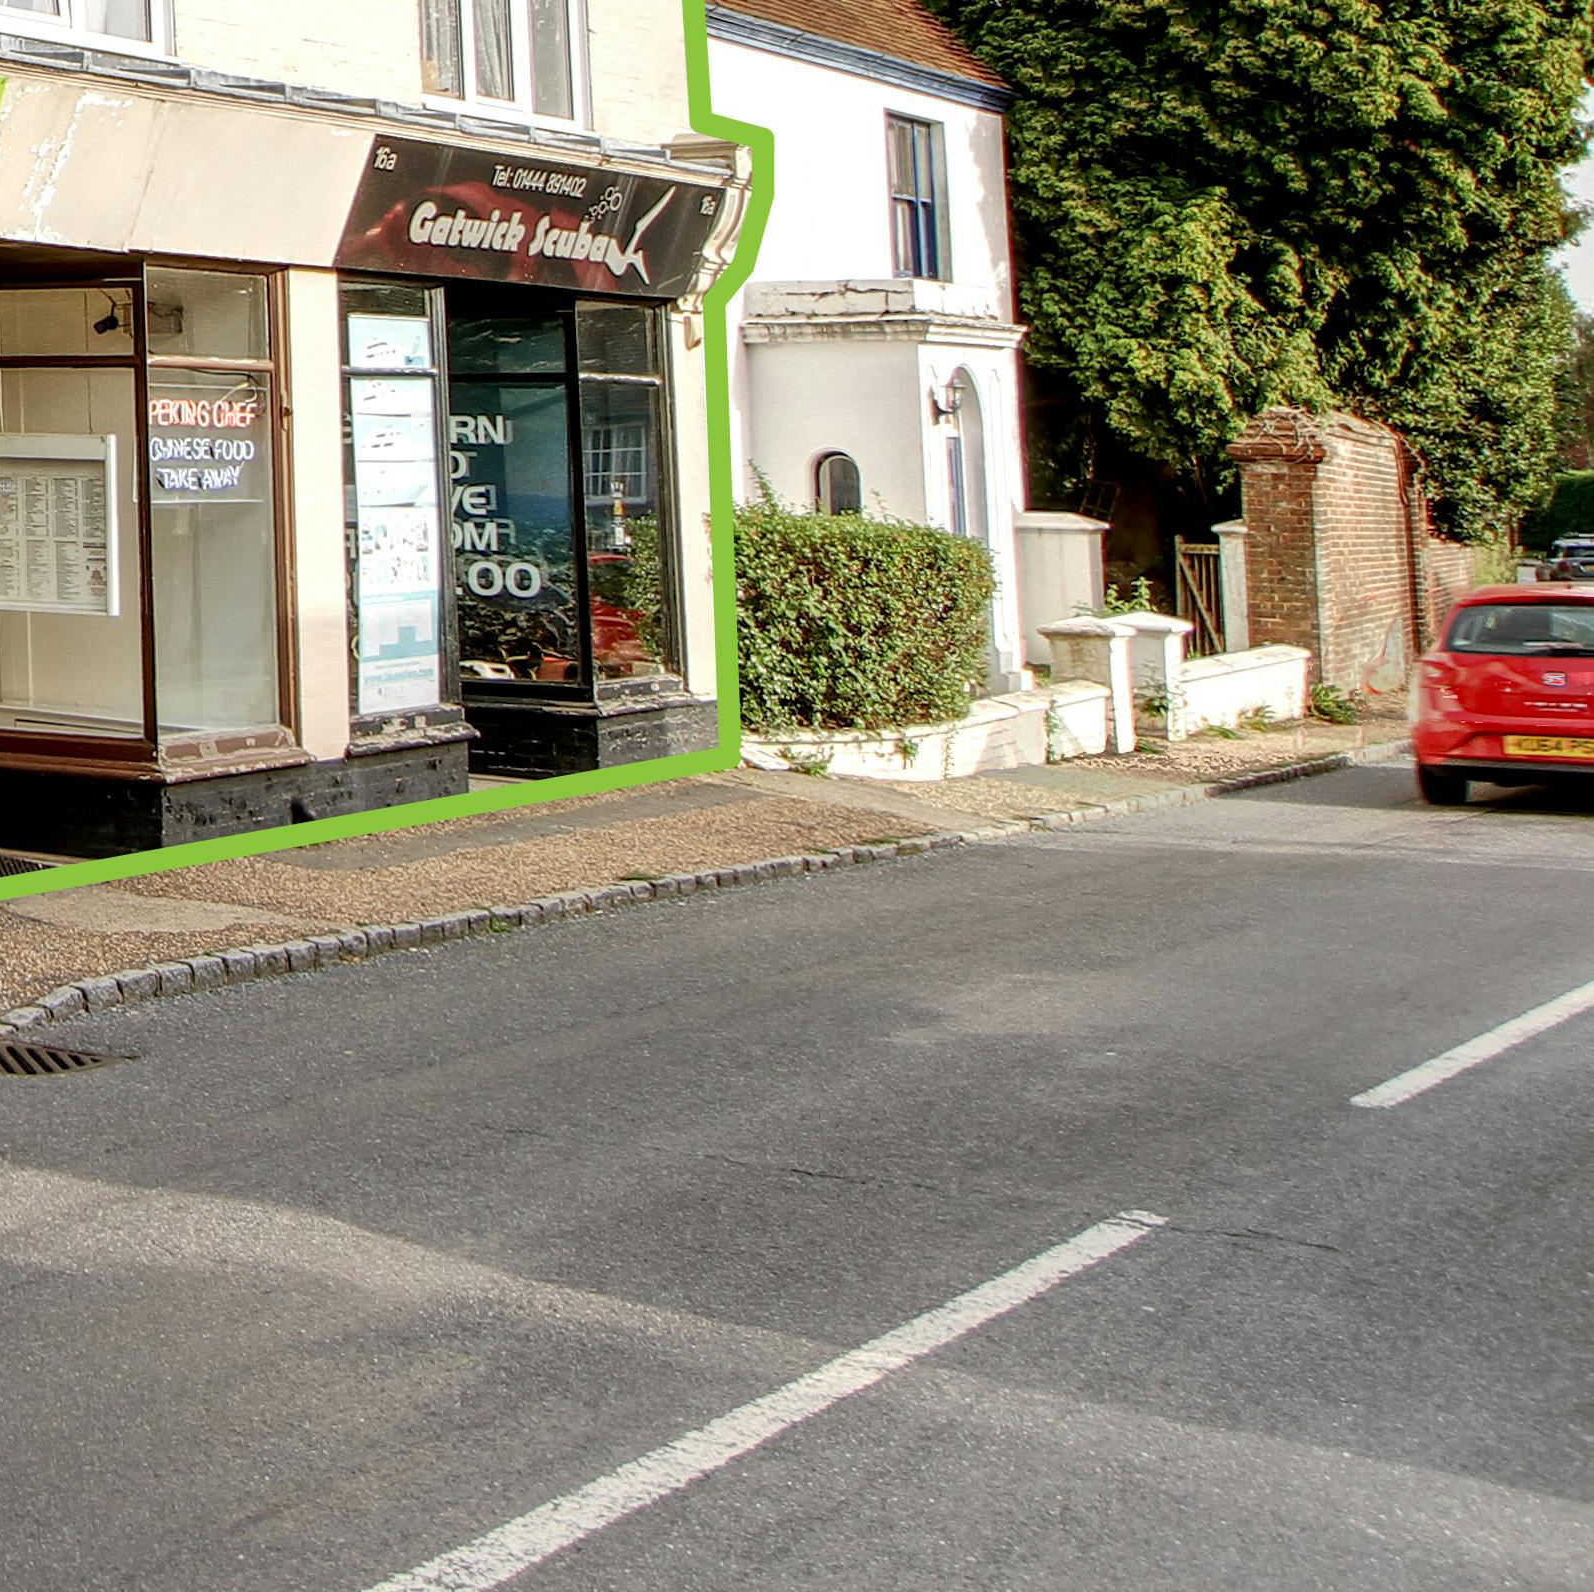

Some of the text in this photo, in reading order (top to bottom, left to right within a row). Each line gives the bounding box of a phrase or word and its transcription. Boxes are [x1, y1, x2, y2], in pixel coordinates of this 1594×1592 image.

[374, 146, 397, 170] 16a
[492, 165, 514, 187] Tel:
[512, 168, 547, 191] 01444
[409, 201, 621, 266] Gatwick Scuba
[149, 399, 258, 428] PEKING CHEF
[213, 439, 255, 461] FOOD
[157, 465, 241, 491] TAKE AWAY
